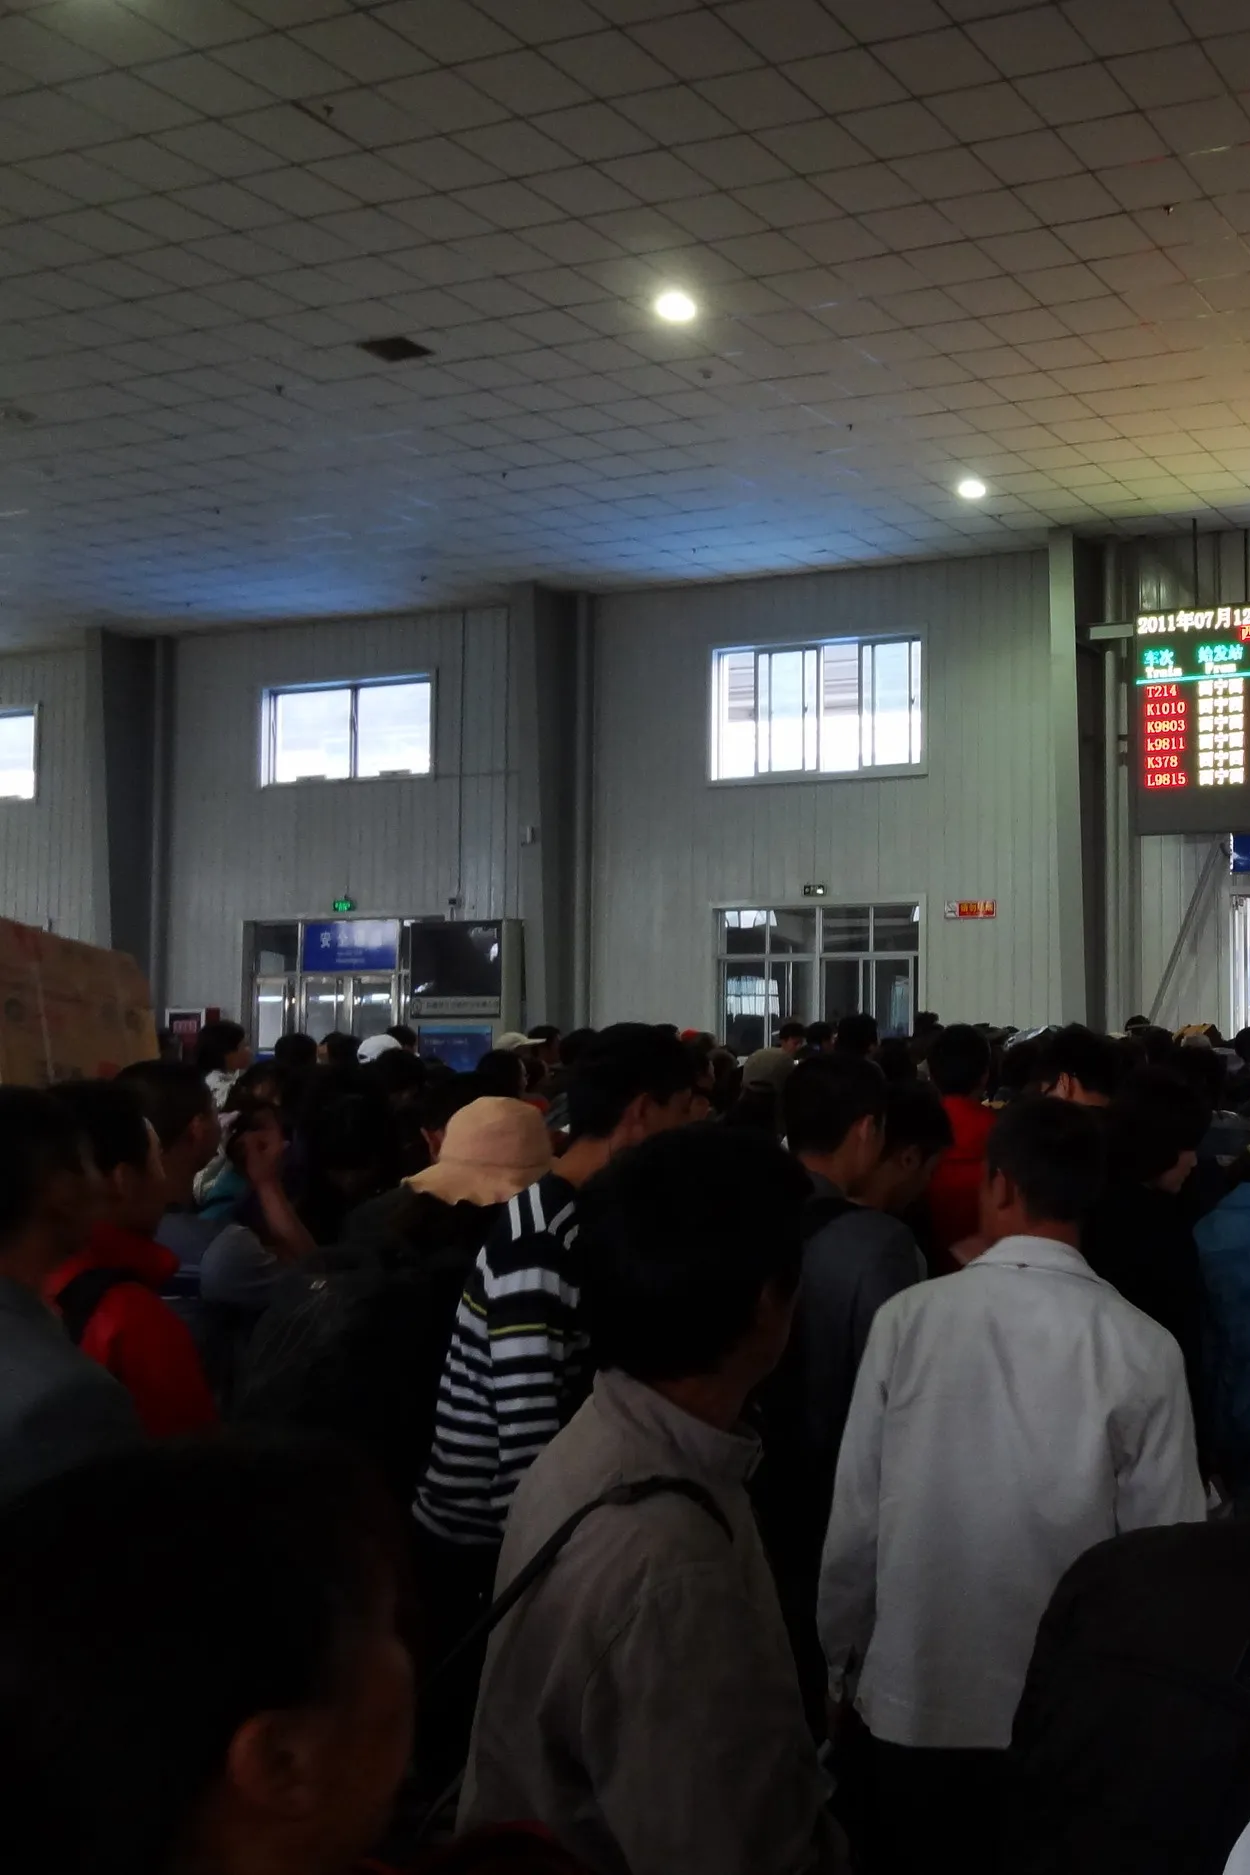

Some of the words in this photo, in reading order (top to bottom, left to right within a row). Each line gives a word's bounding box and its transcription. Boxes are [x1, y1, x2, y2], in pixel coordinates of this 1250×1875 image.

[1144, 649, 1174, 666] 车次
[1146, 684, 1178, 699] T214
[1146, 701, 1187, 717] K1010
[1147, 719, 1187, 735] K9803
[1147, 756, 1179, 770] K378
[1147, 774, 1188, 788] L9815
